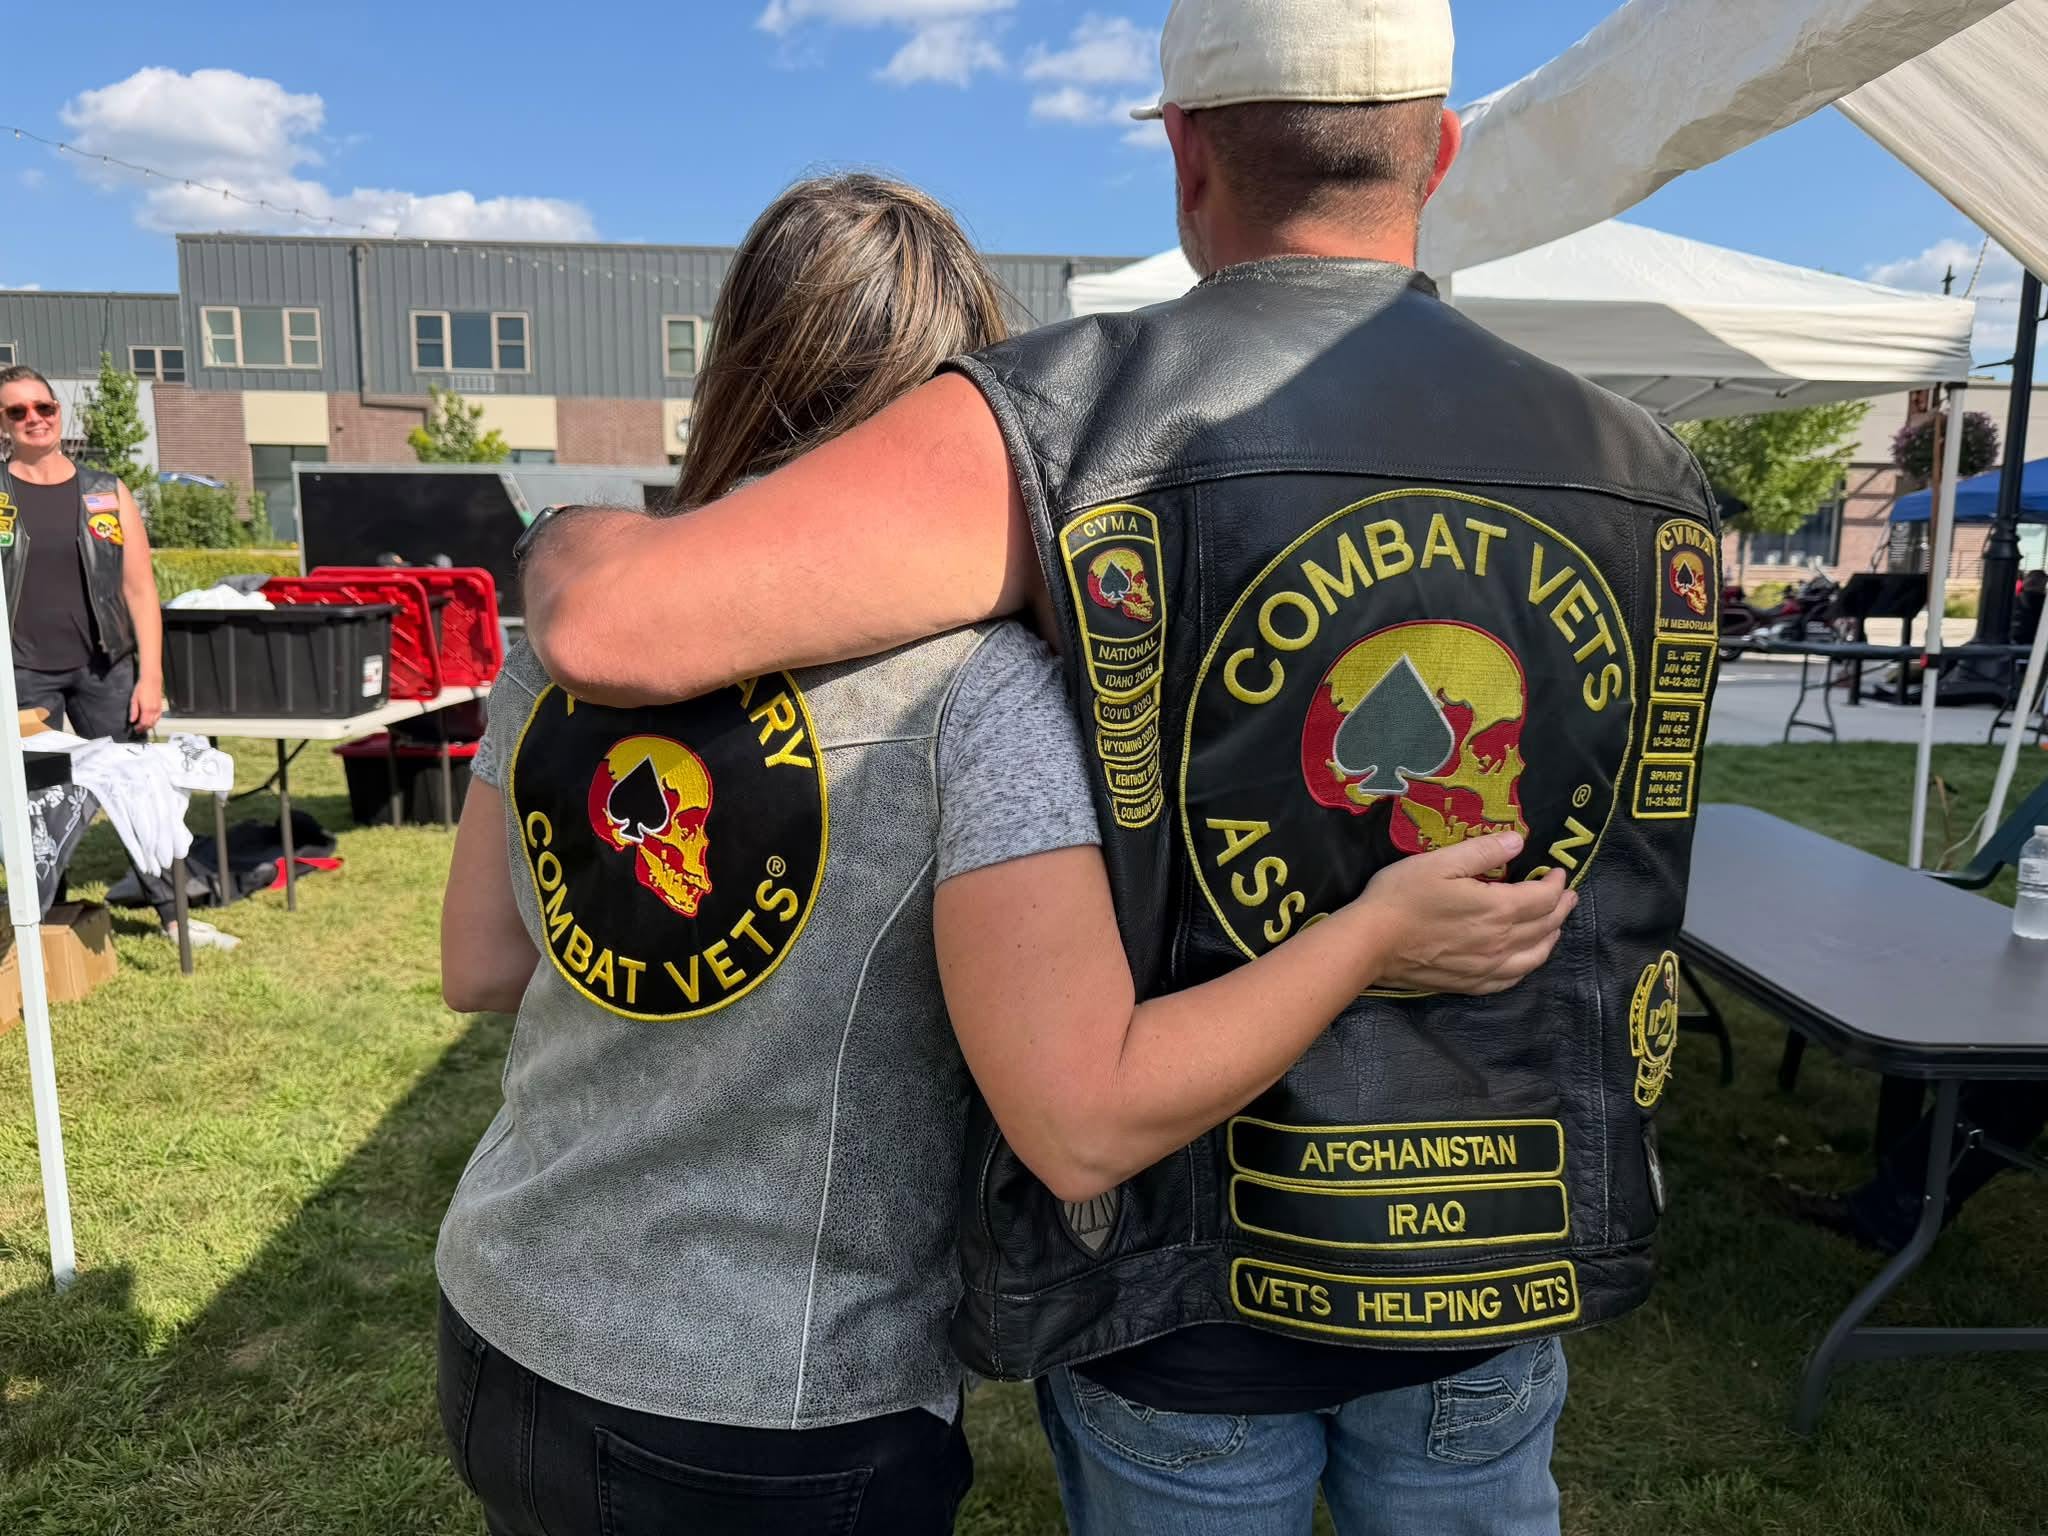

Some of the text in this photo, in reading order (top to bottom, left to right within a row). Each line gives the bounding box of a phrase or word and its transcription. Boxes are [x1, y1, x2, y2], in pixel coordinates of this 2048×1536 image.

[1083, 515, 1138, 538] CVMA
[1660, 525, 1712, 557] CVMA
[1223, 513, 1622, 712] COMBAT VETS
[1098, 636, 1158, 661] NATIONAL
[1105, 662, 1154, 688] IDAHO 2019
[1103, 694, 1152, 720] COVID 2020
[1103, 736, 1142, 753] WYOMING
[1650, 770, 1683, 781] SPARKS
[526, 810, 647, 1004] COMBAT
[1300, 1134, 1517, 1173] AFGHANISTAN
[1388, 1200, 1467, 1236] IRAQ
[1246, 1272, 1568, 1324] VETS HELPING VETS
